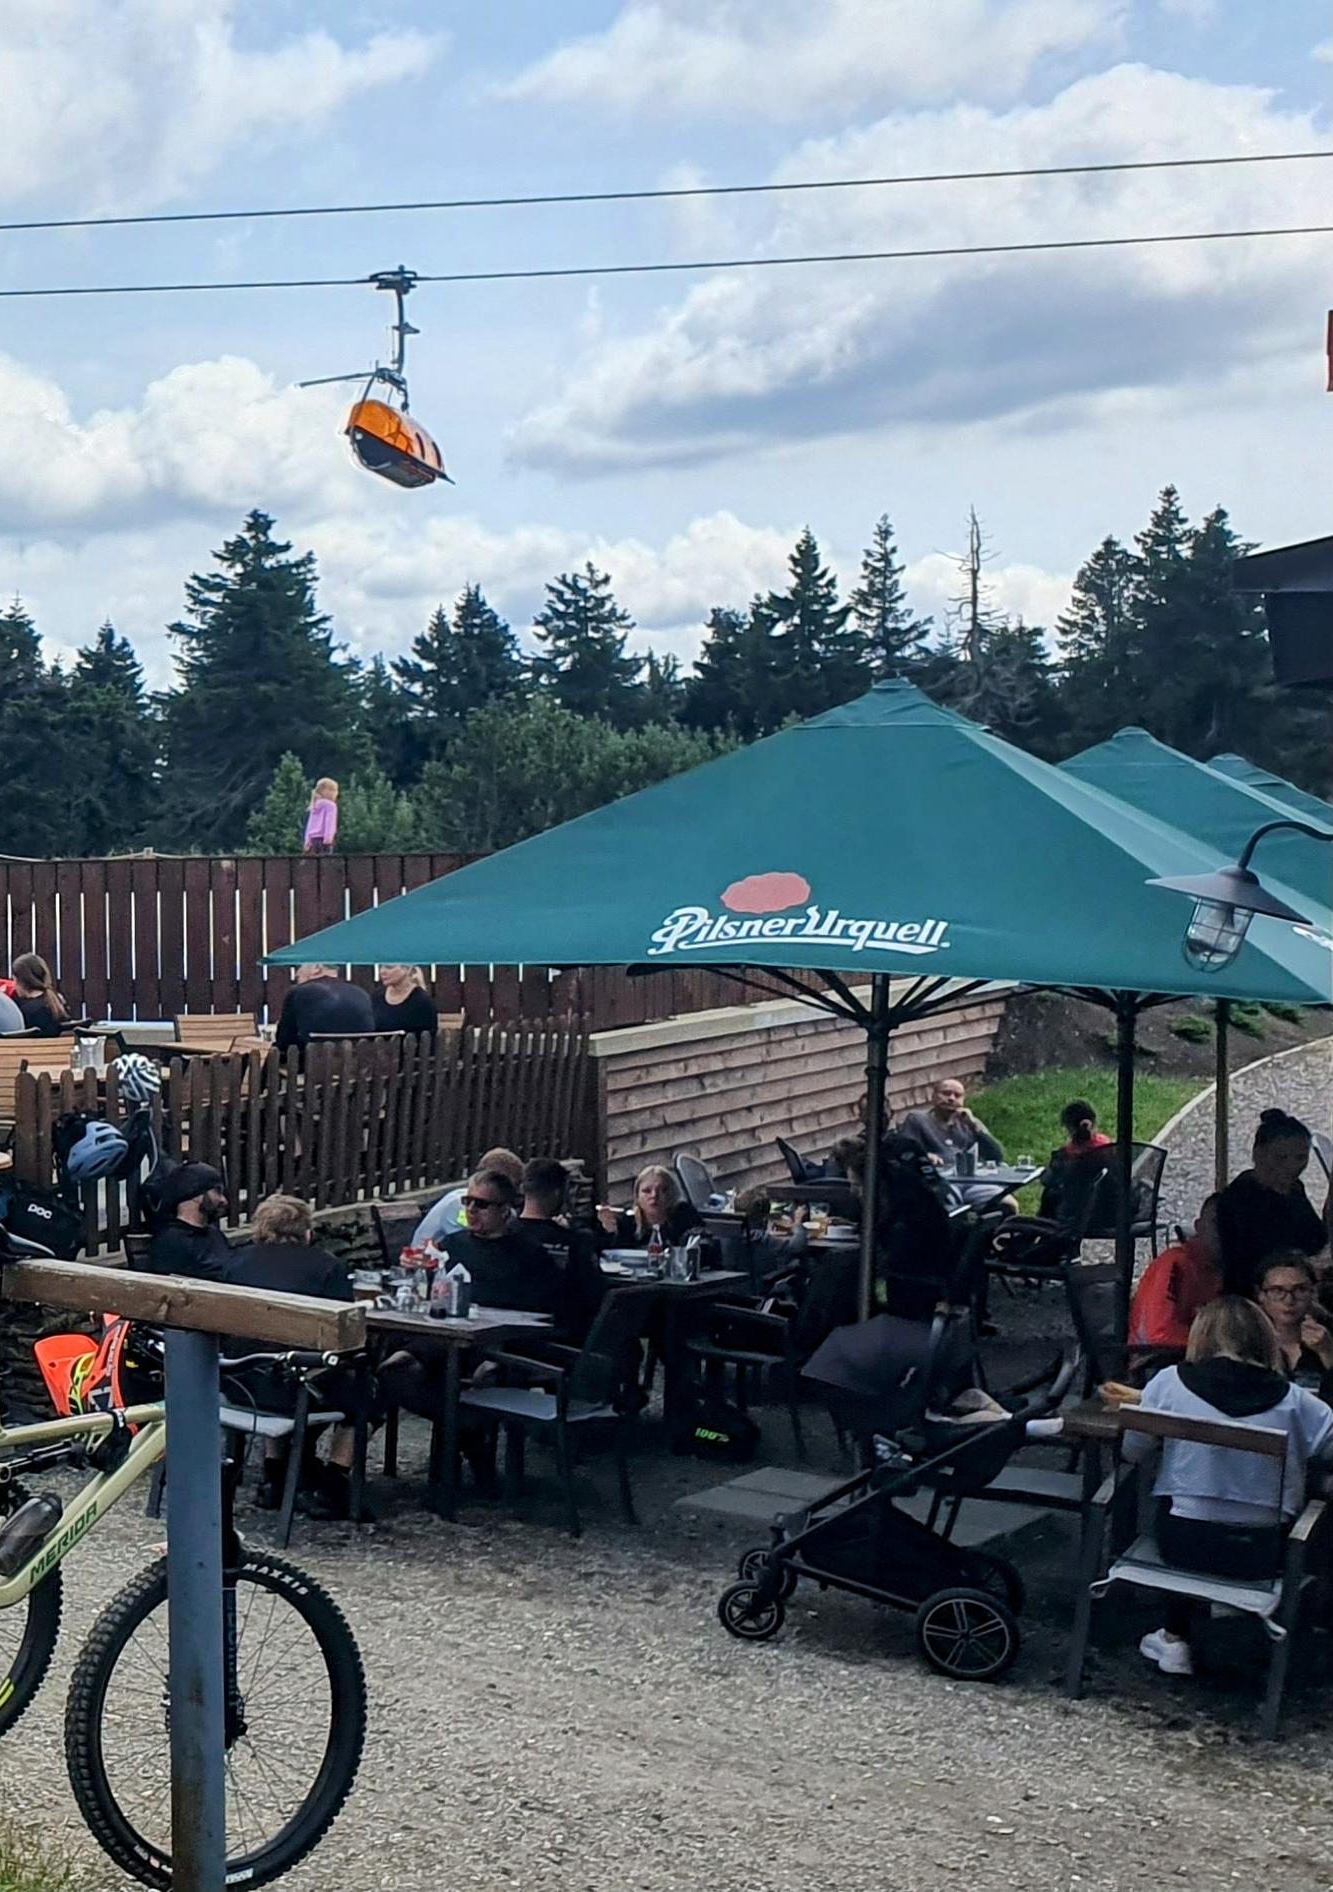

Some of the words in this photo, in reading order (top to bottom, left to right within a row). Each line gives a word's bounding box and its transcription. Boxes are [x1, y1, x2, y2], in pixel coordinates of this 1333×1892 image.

[646, 906, 808, 955] Pilsner
[802, 904, 950, 952] Urquell
[29, 1502, 97, 1583] MERIDA
[242, 1563, 310, 1595] MAXXIS
